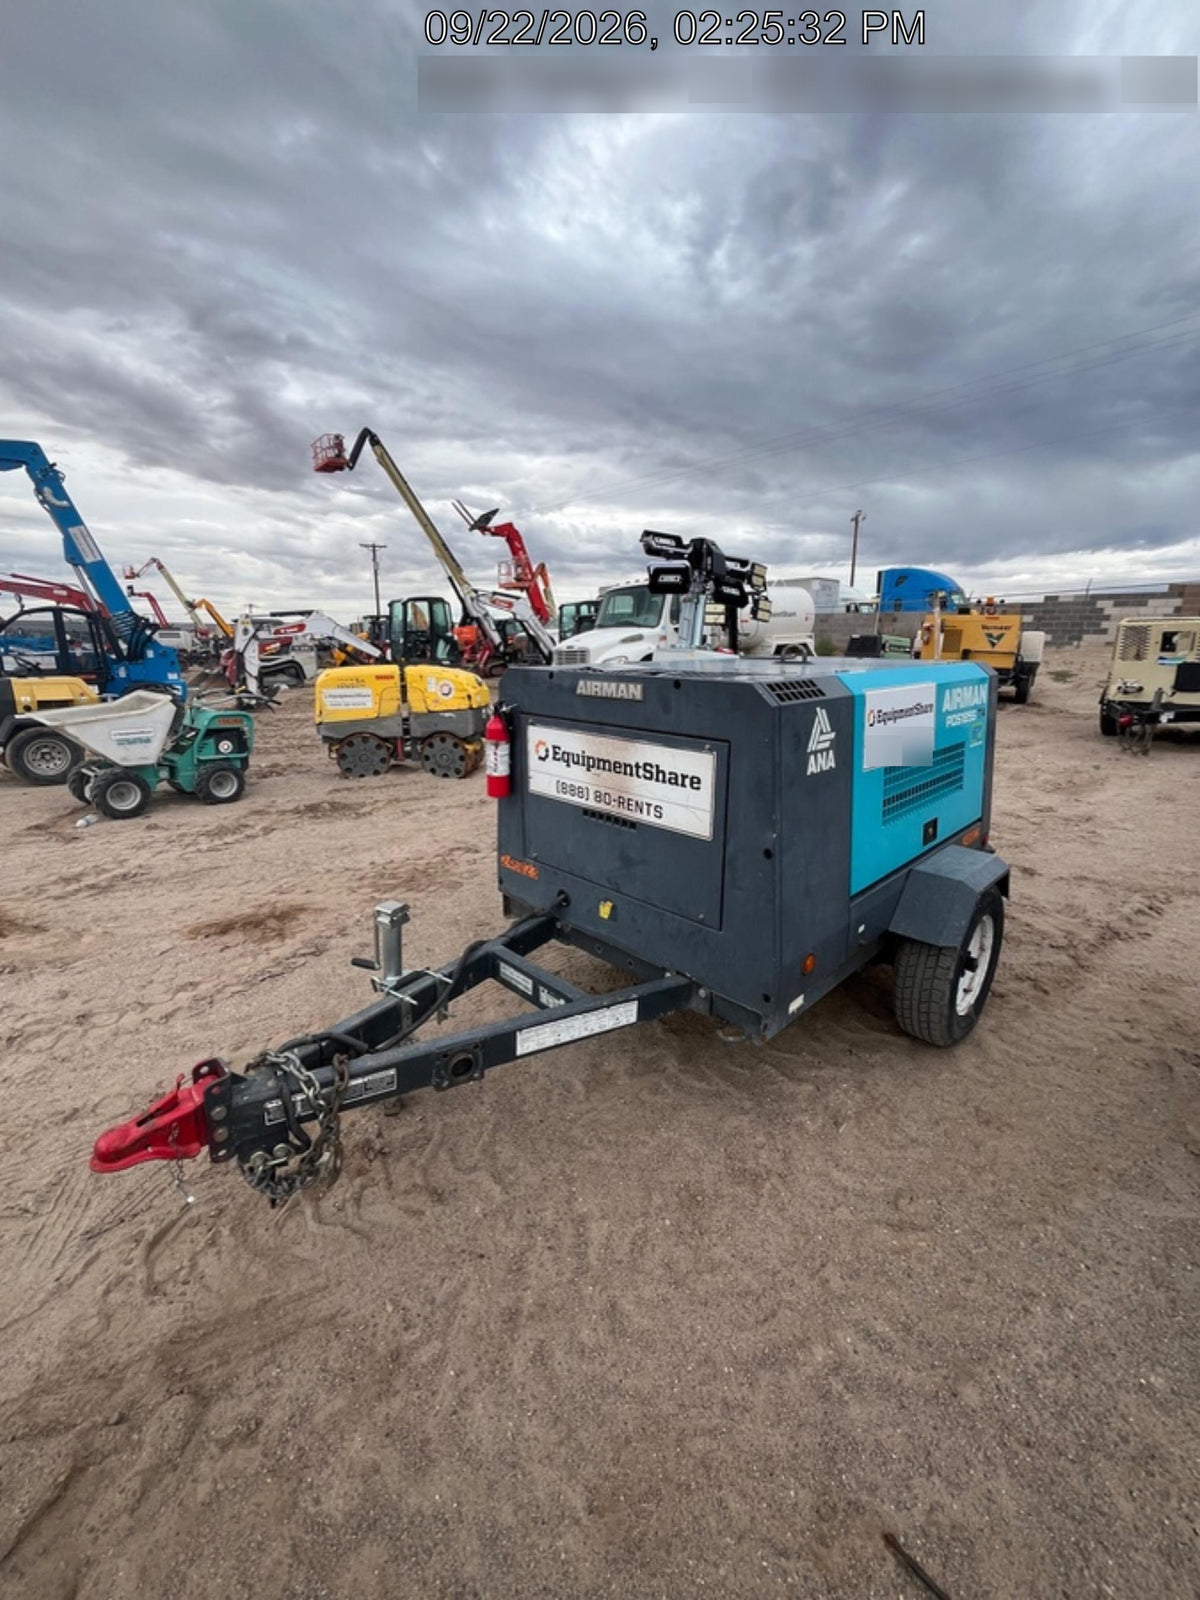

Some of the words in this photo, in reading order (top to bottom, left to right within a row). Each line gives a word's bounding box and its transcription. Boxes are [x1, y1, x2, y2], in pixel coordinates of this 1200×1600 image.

[576, 680, 644, 701] AIRMAN
[942, 683, 988, 712] AIRMAN
[552, 745, 702, 791] EquipmentShare
[806, 750, 837, 776] ANA
[593, 790, 664, 819] 80-RENTS
